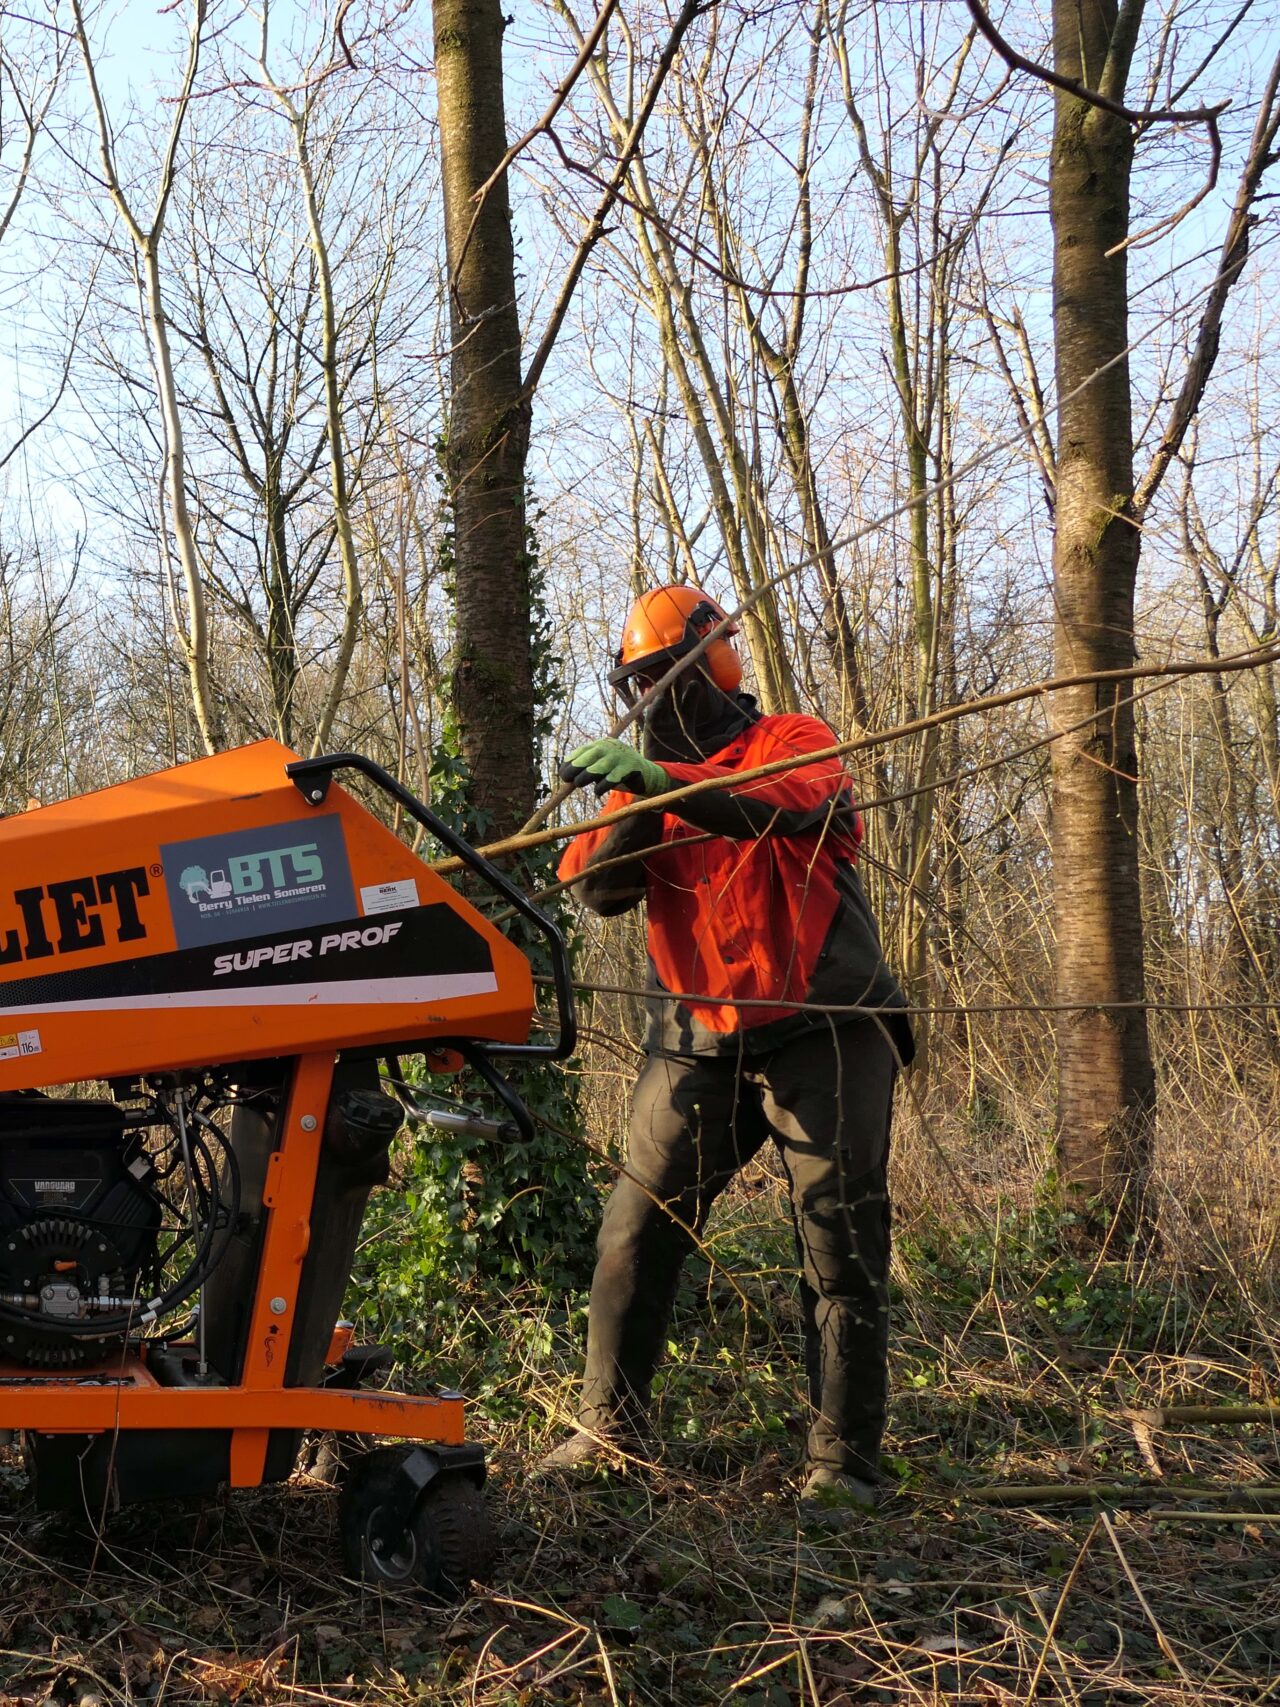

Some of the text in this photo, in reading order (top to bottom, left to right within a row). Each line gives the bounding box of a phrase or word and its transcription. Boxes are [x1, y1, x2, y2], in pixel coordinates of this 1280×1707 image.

[228, 843, 323, 894] BTS
[199, 899, 233, 912] Berry
[235, 893, 271, 905] Tielen
[274, 884, 326, 899] Someren
[213, 922, 403, 976] SUPER PROF
[21, 1041, 34, 1054] 116
[34, 1181, 76, 1190] VANGUARD
